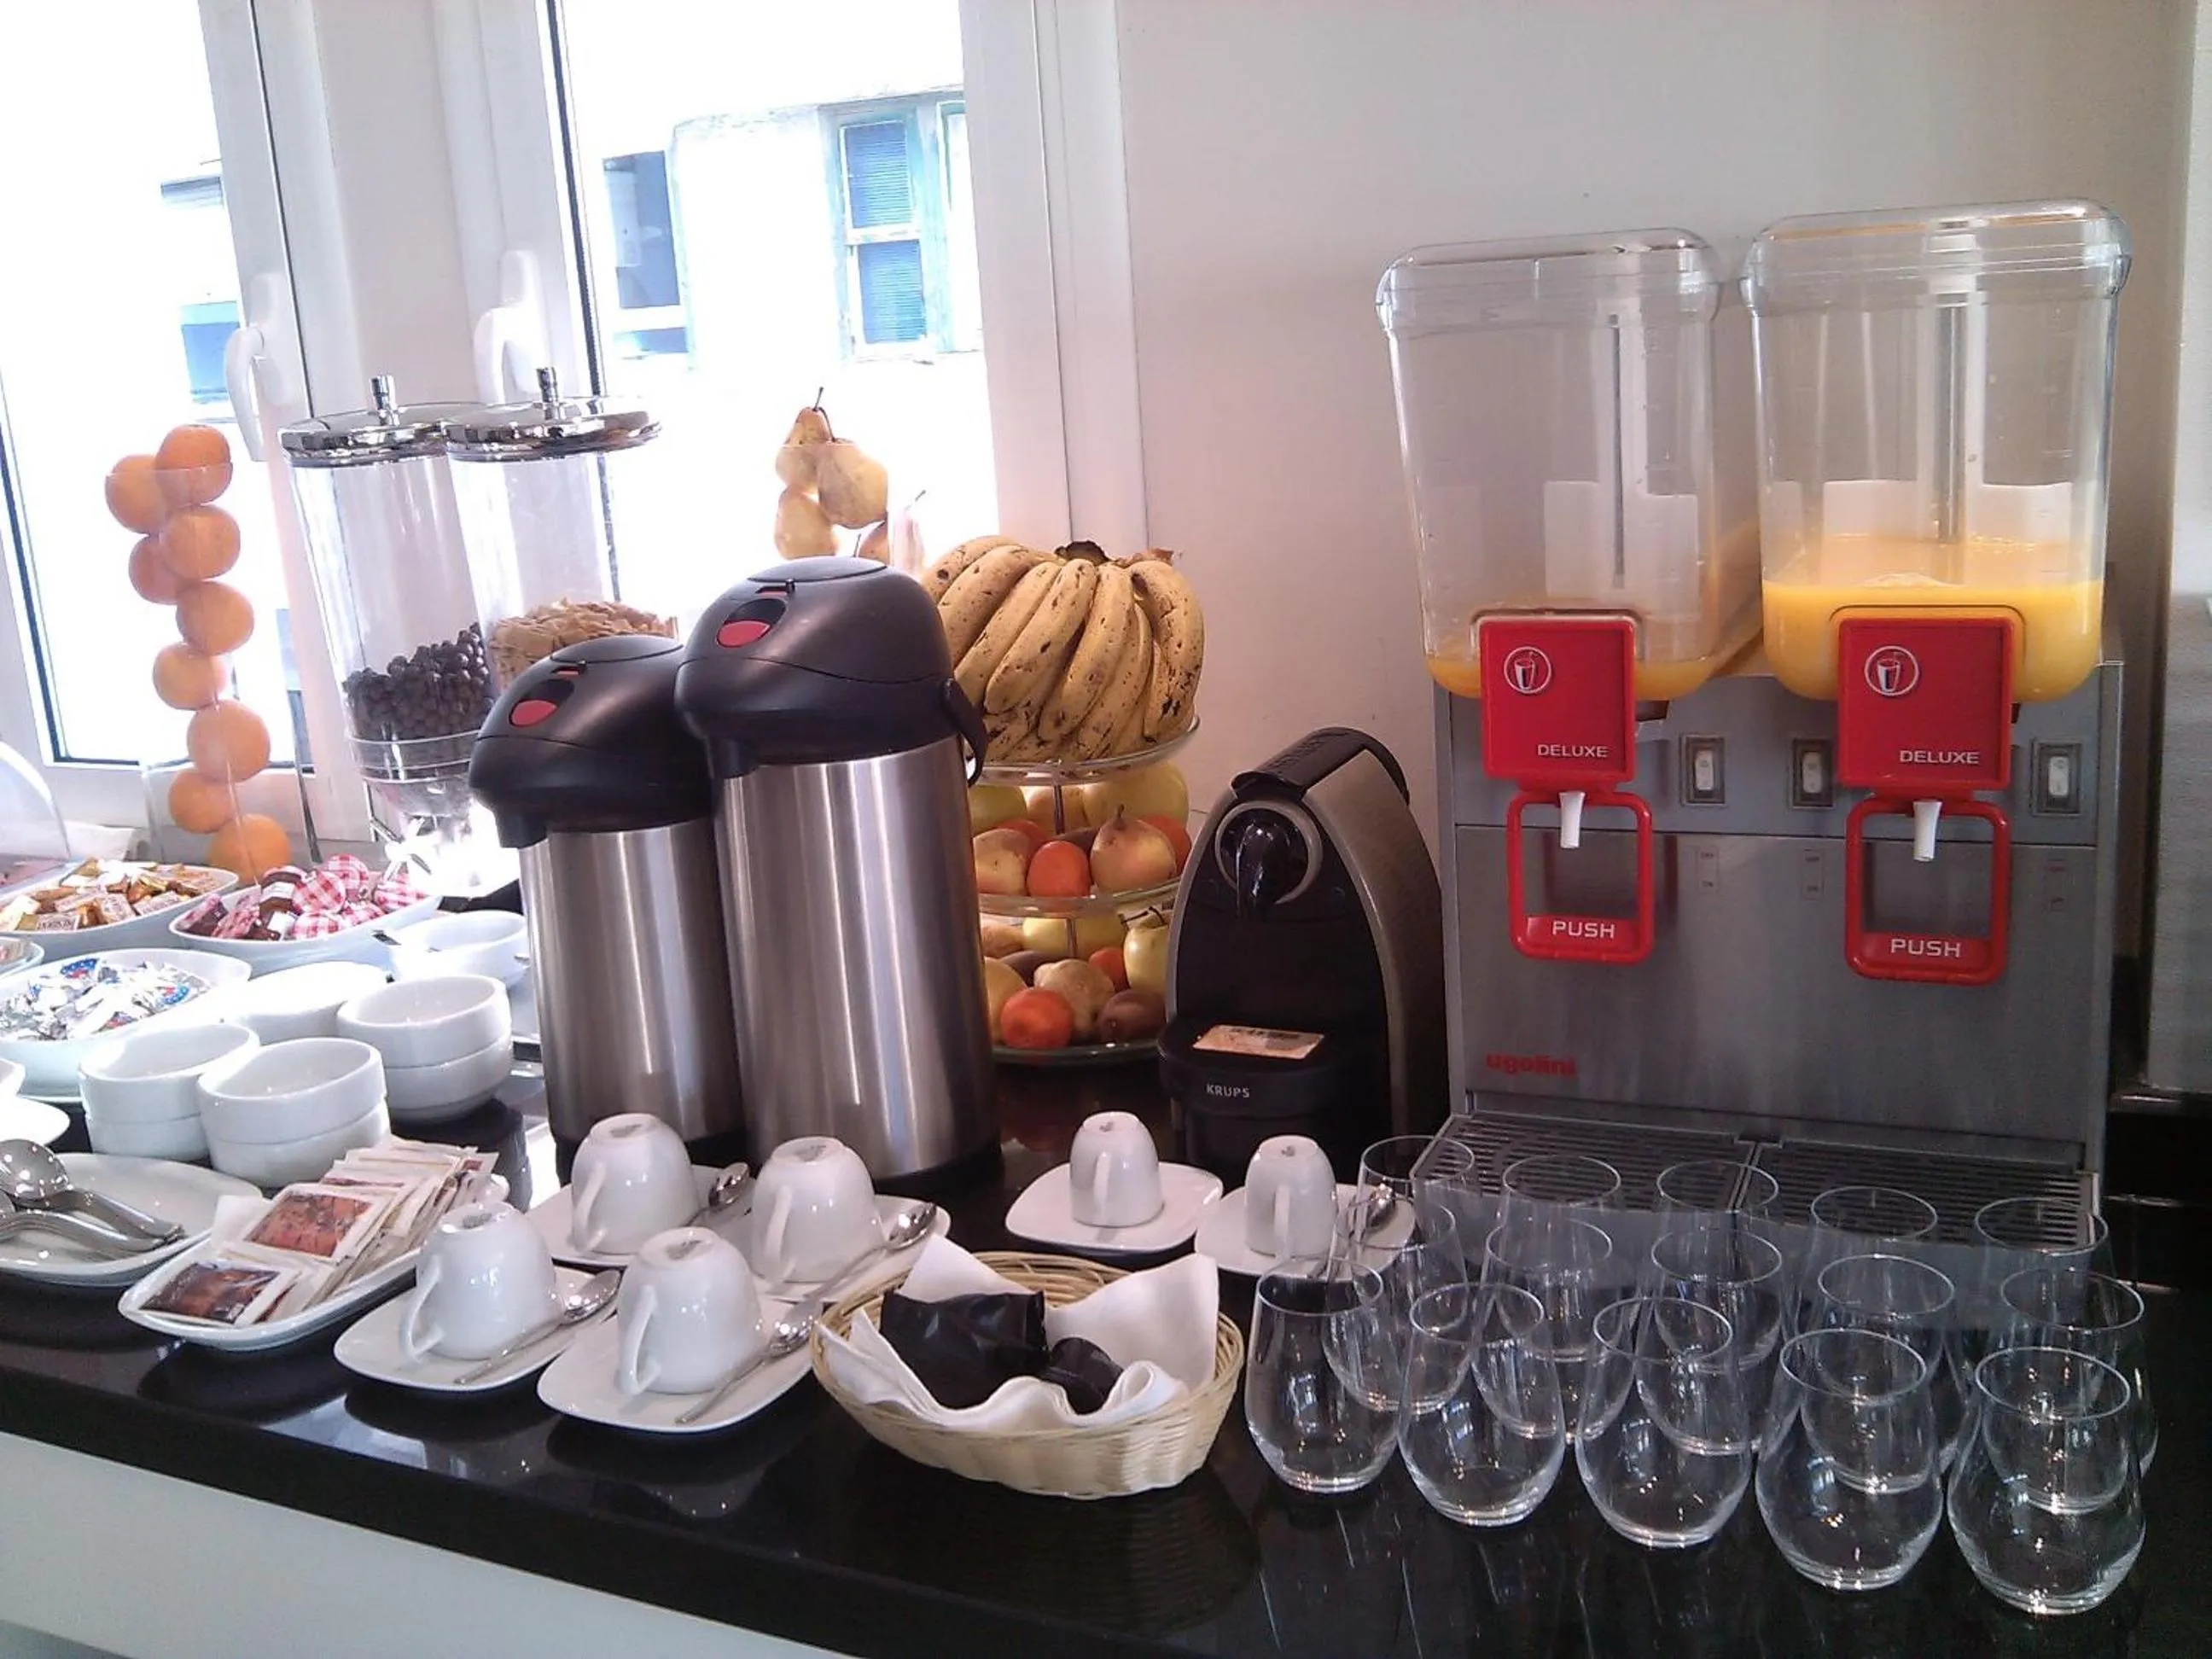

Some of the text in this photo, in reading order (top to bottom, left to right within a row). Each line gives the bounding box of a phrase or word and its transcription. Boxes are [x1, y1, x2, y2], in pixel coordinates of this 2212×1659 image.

[1537, 743, 1610, 758] DELUXE
[1900, 750, 1980, 765] DELUXE
[1552, 920, 1615, 939] PUSH
[1890, 938, 1961, 958] PUSH
[1206, 1082, 1250, 1098] KRUPS
